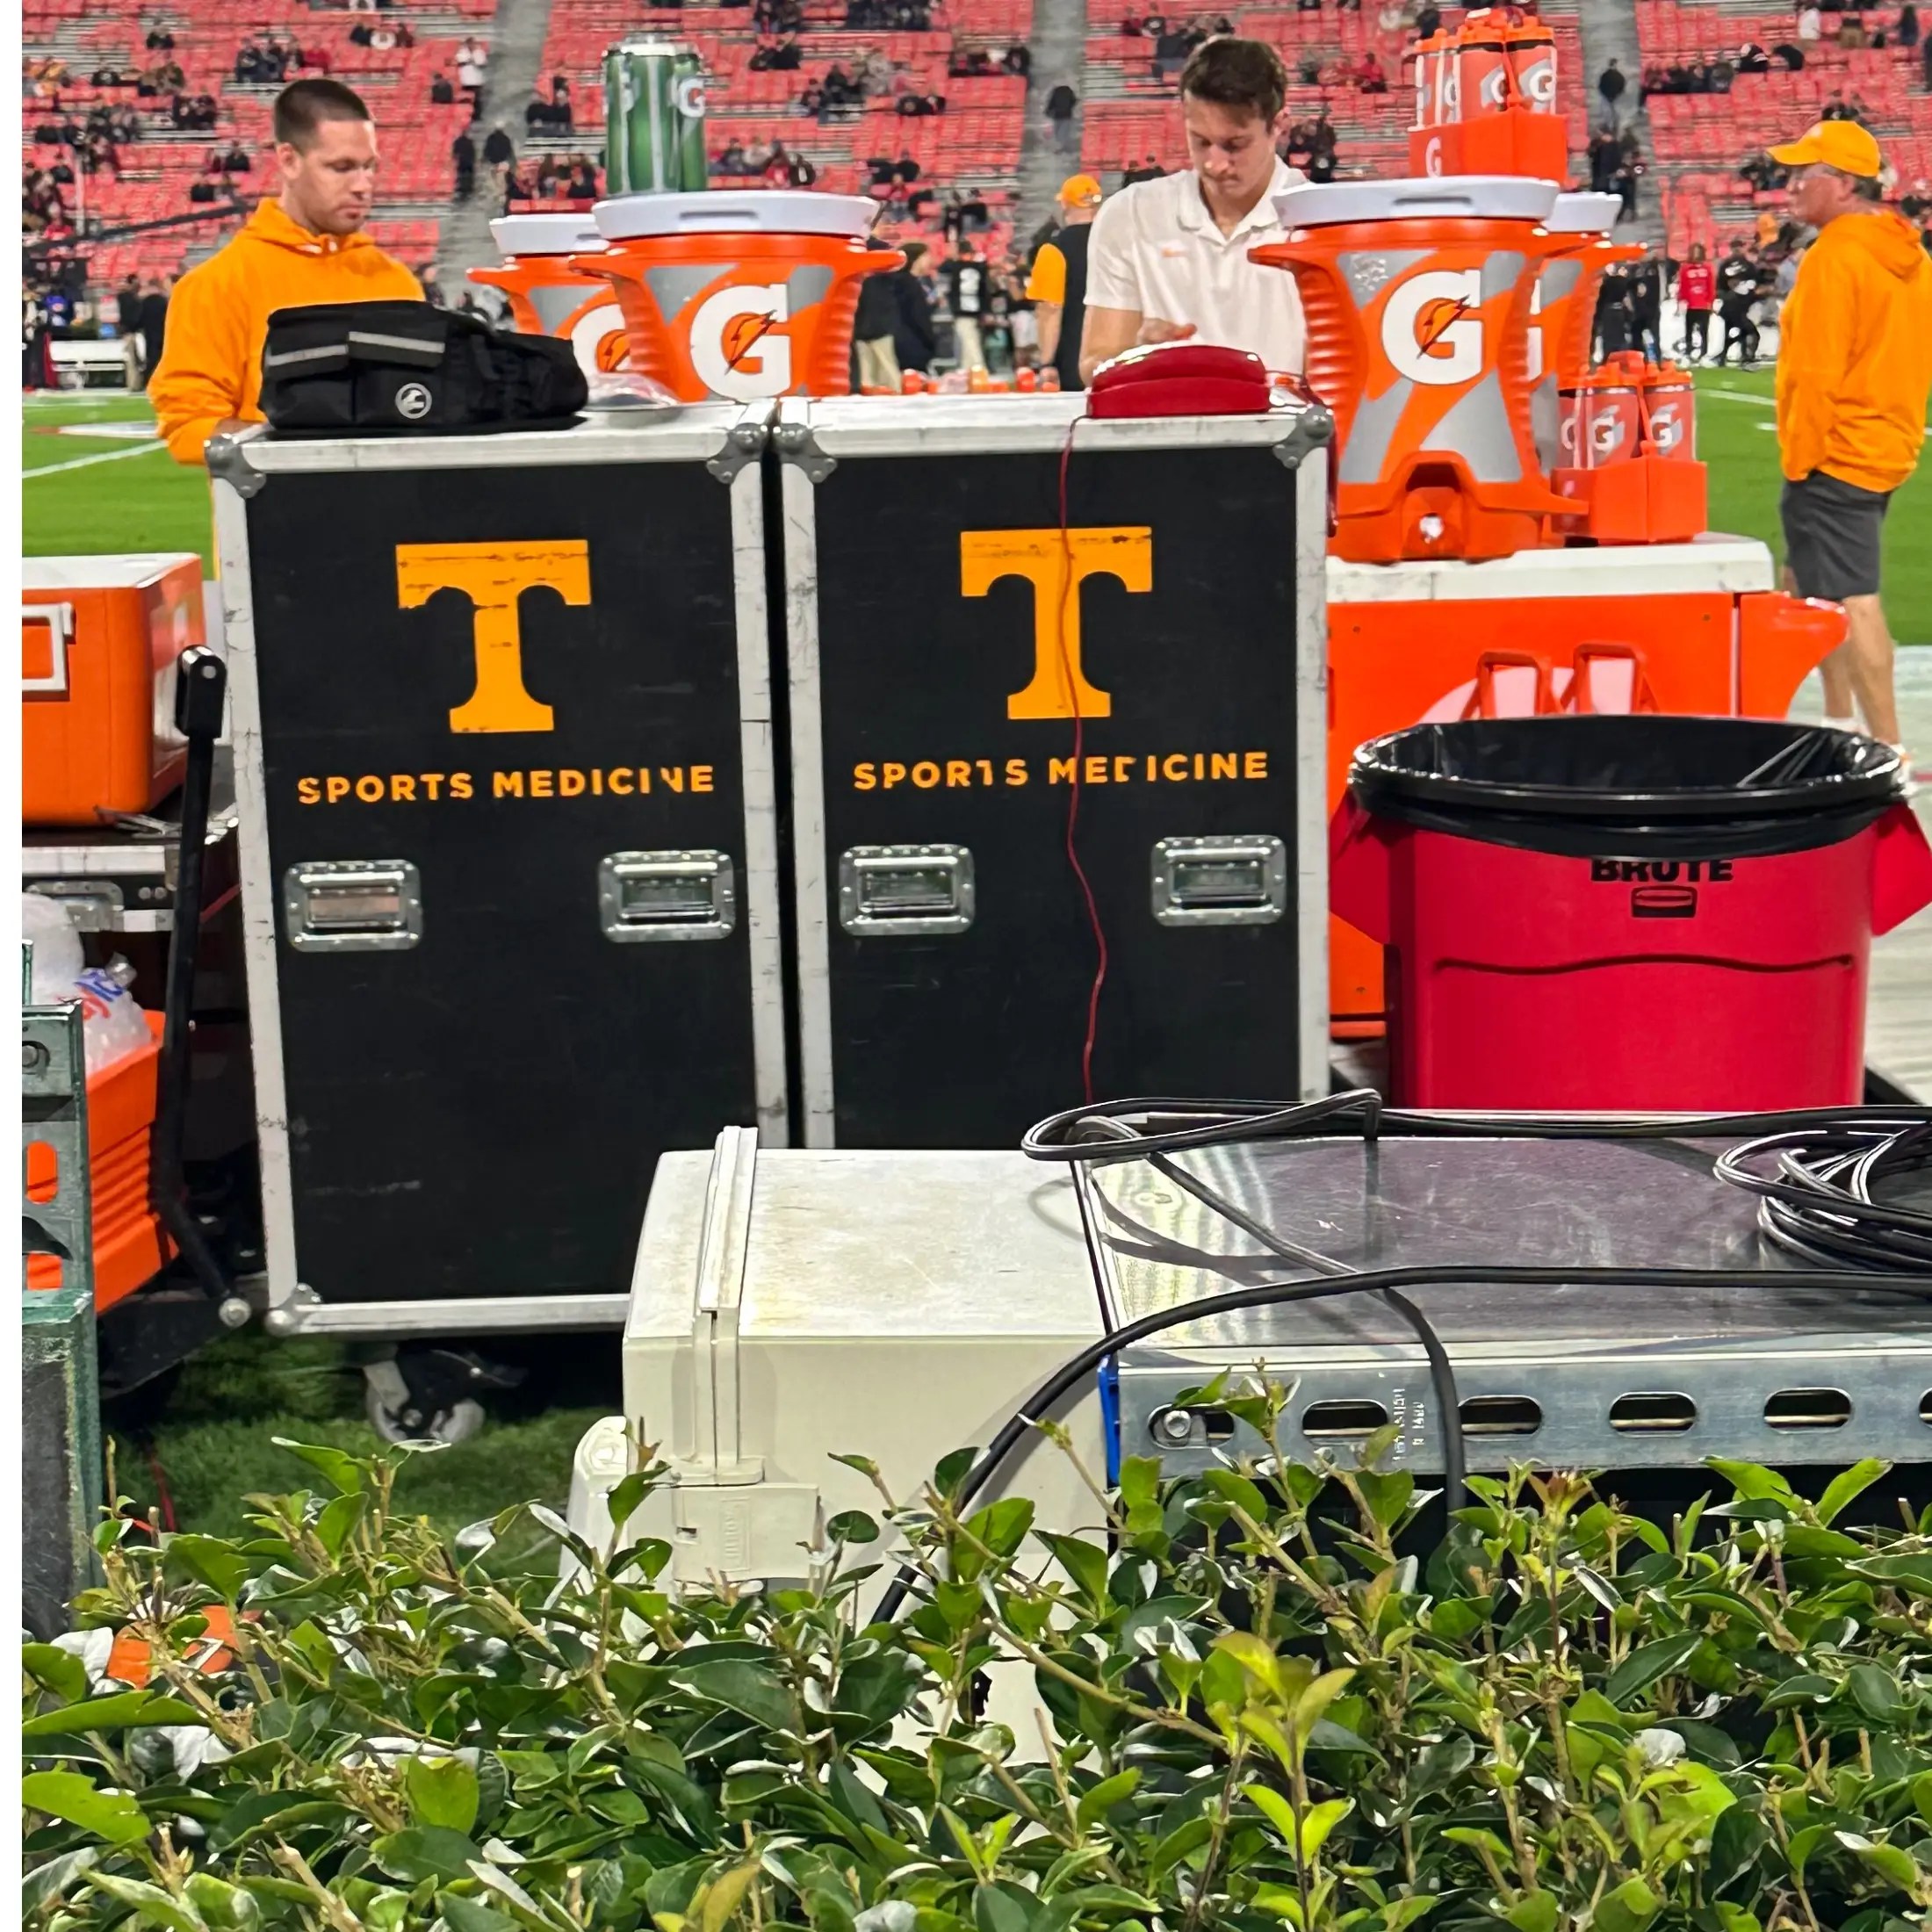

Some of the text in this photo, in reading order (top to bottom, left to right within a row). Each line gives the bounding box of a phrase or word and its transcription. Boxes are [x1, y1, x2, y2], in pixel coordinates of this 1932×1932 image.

[679, 77, 705, 118] G
[1530, 68, 1556, 101] G
[690, 284, 791, 398] G
[1381, 270, 1482, 385] G
[1592, 415, 1615, 453] G
[1651, 414, 1673, 449] G
[396, 540, 592, 733] T
[961, 527, 1152, 720] T
[297, 765, 714, 804] SPORTS MEDICINE
[854, 759, 1028, 790] SPORTS
[1591, 860, 1734, 883] BRUTE
